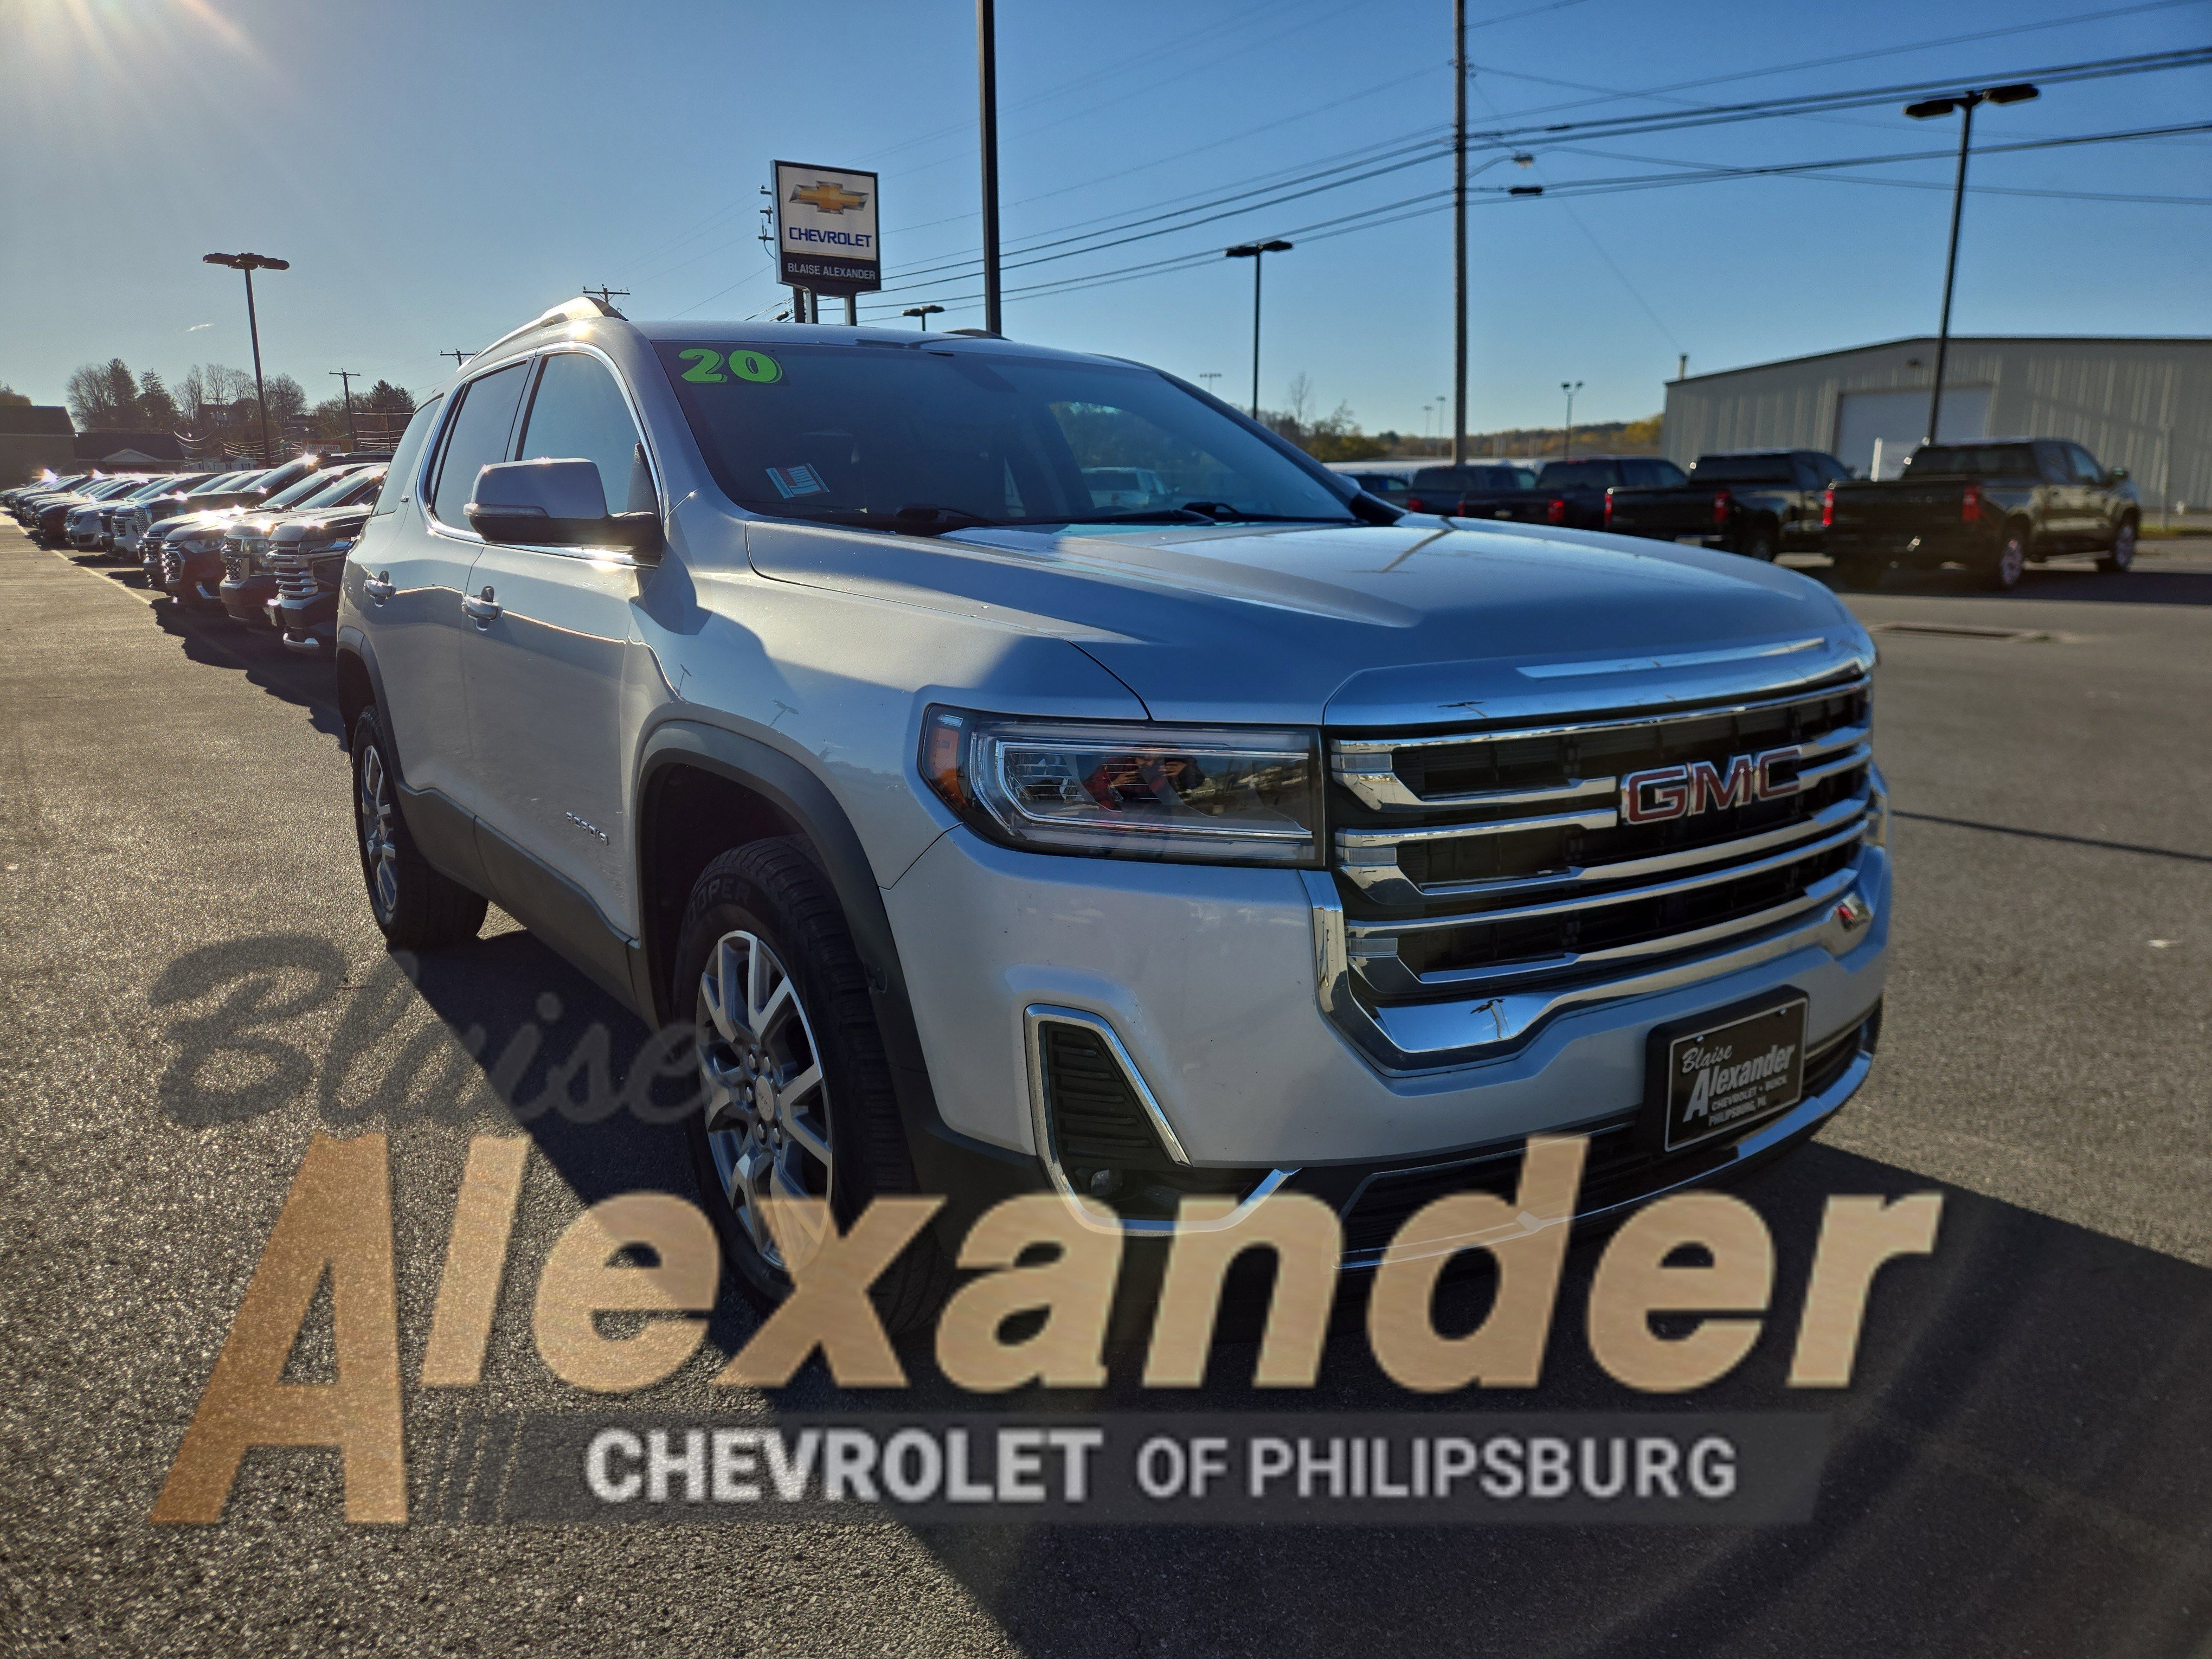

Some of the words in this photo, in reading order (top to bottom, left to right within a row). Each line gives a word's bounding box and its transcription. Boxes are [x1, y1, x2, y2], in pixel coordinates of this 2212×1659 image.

[789, 227, 872, 247] CHEVROLET
[788, 262, 820, 275] BLAISE
[822, 266, 876, 280] ALEXANDER
[679, 348, 782, 383] 20
[1621, 744, 1802, 825] GMC
[1682, 1045, 1732, 1073] Blaise
[1683, 1044, 1796, 1122] Alexander
